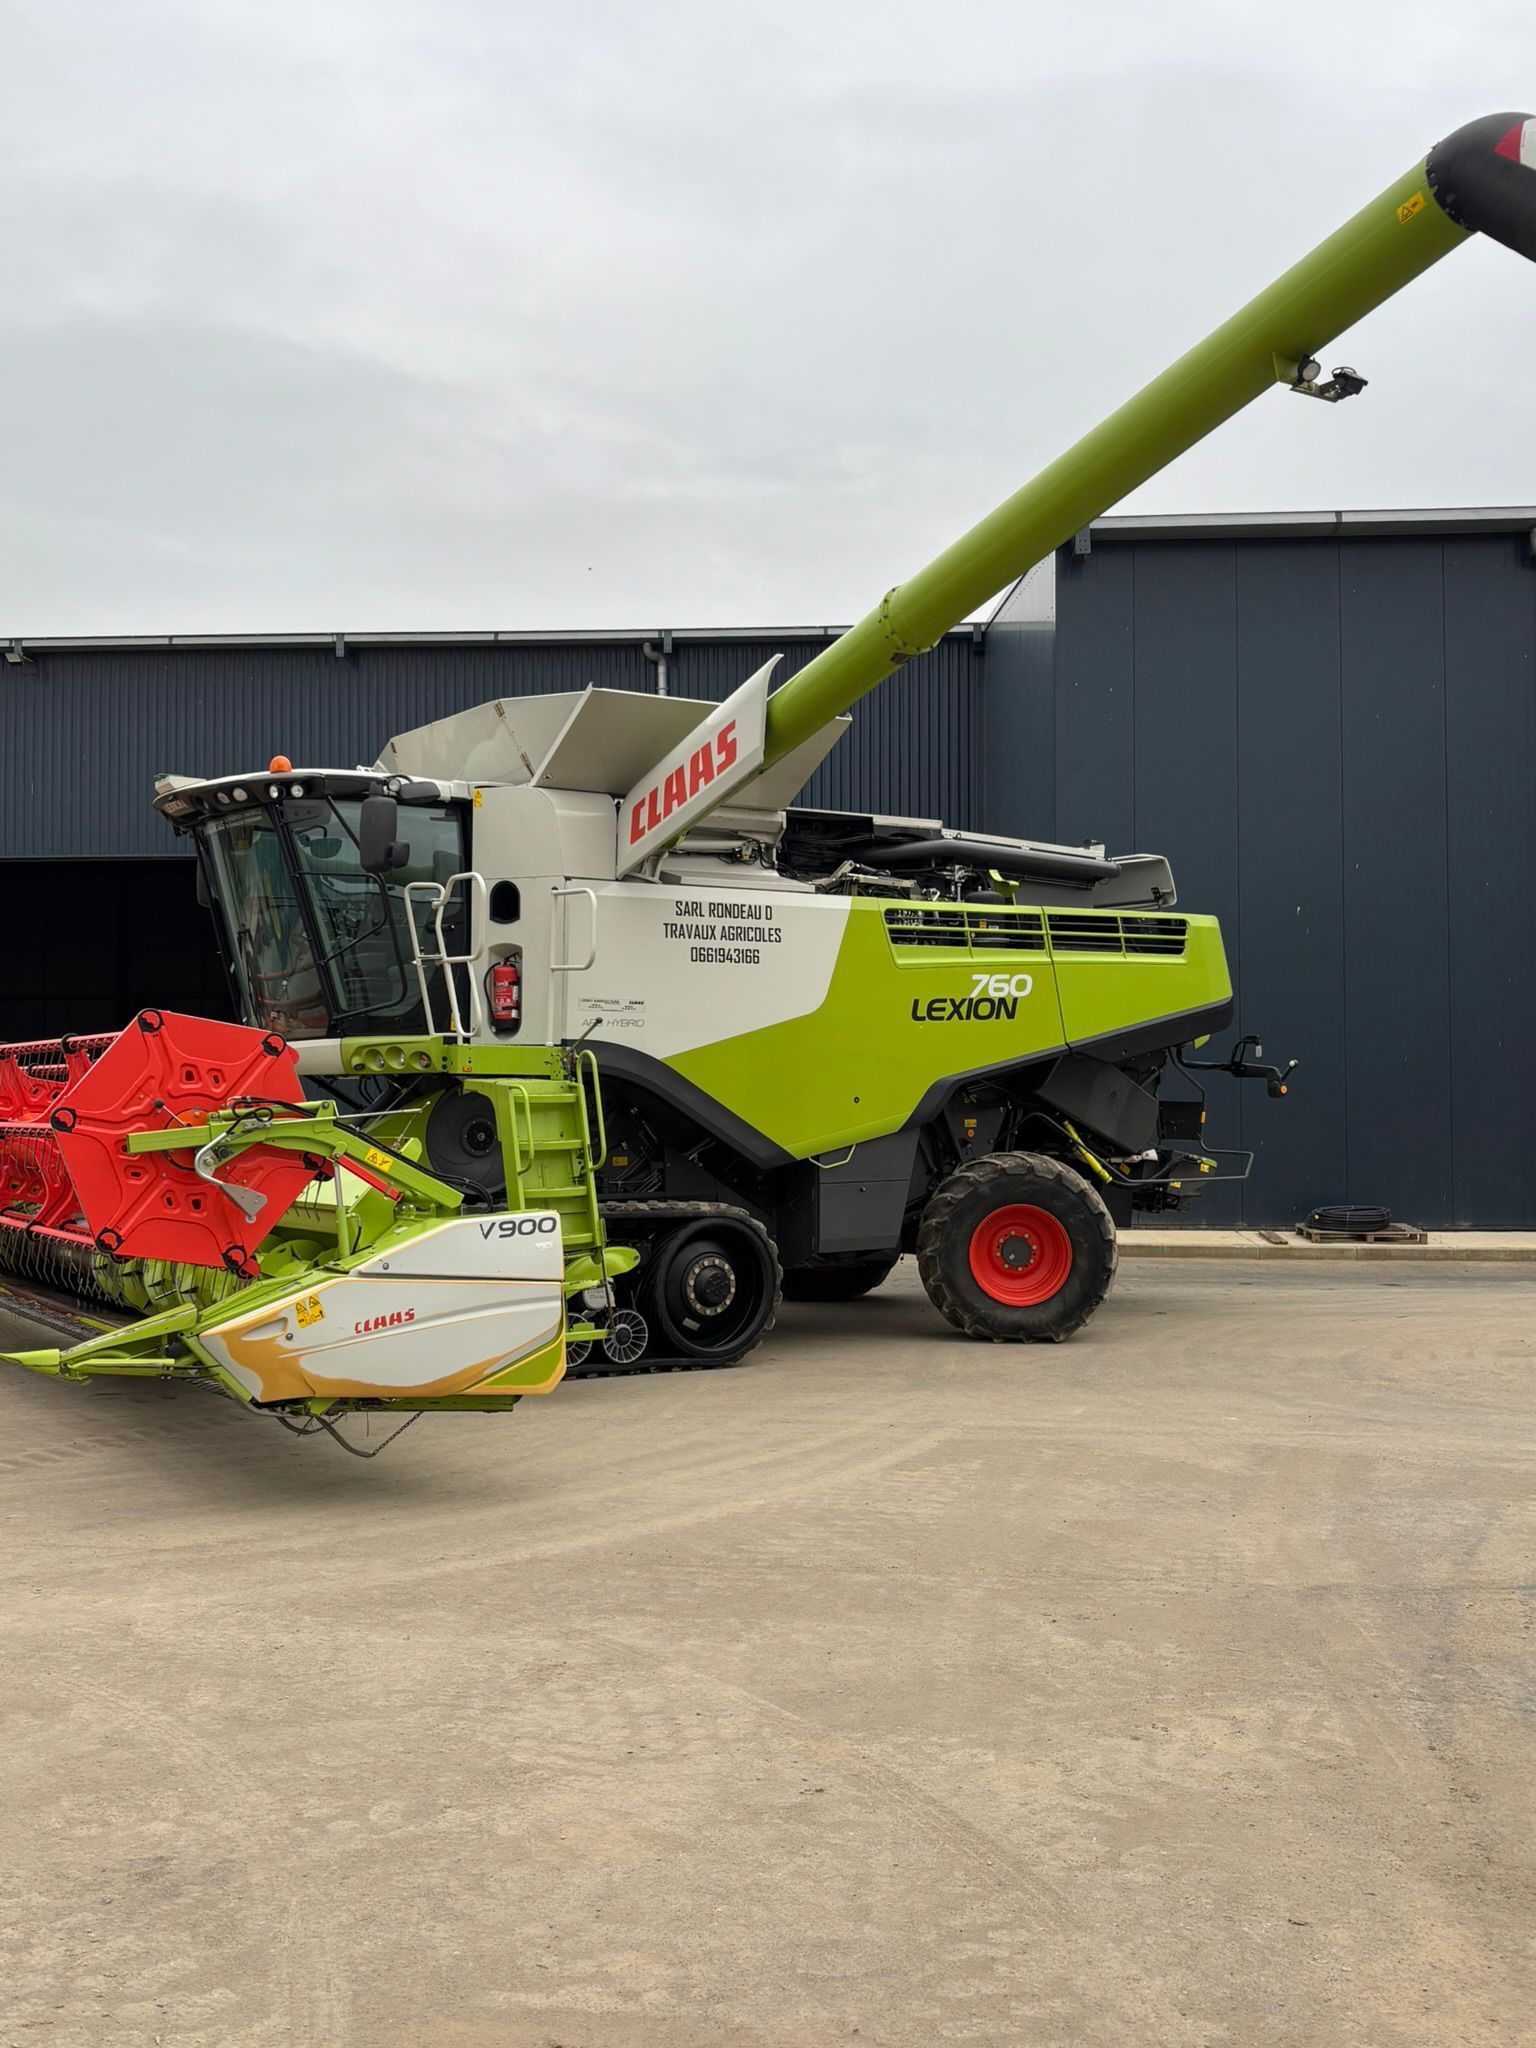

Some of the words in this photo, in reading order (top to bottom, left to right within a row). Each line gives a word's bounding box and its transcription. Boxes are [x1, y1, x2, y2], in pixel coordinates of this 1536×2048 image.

[630, 719, 737, 845] CLAAS
[675, 900, 704, 917] SARL
[709, 902, 761, 920] RONDEAU
[765, 905, 772, 920] D
[663, 923, 716, 940] TRAVAUX
[720, 925, 781, 943] AGRICOLES
[690, 946, 760, 964] 0661943166
[969, 974, 1033, 998] 760
[911, 997, 1018, 1021] LEXION
[480, 1217, 557, 1240] V900
[354, 1307, 415, 1335] CLAAS
